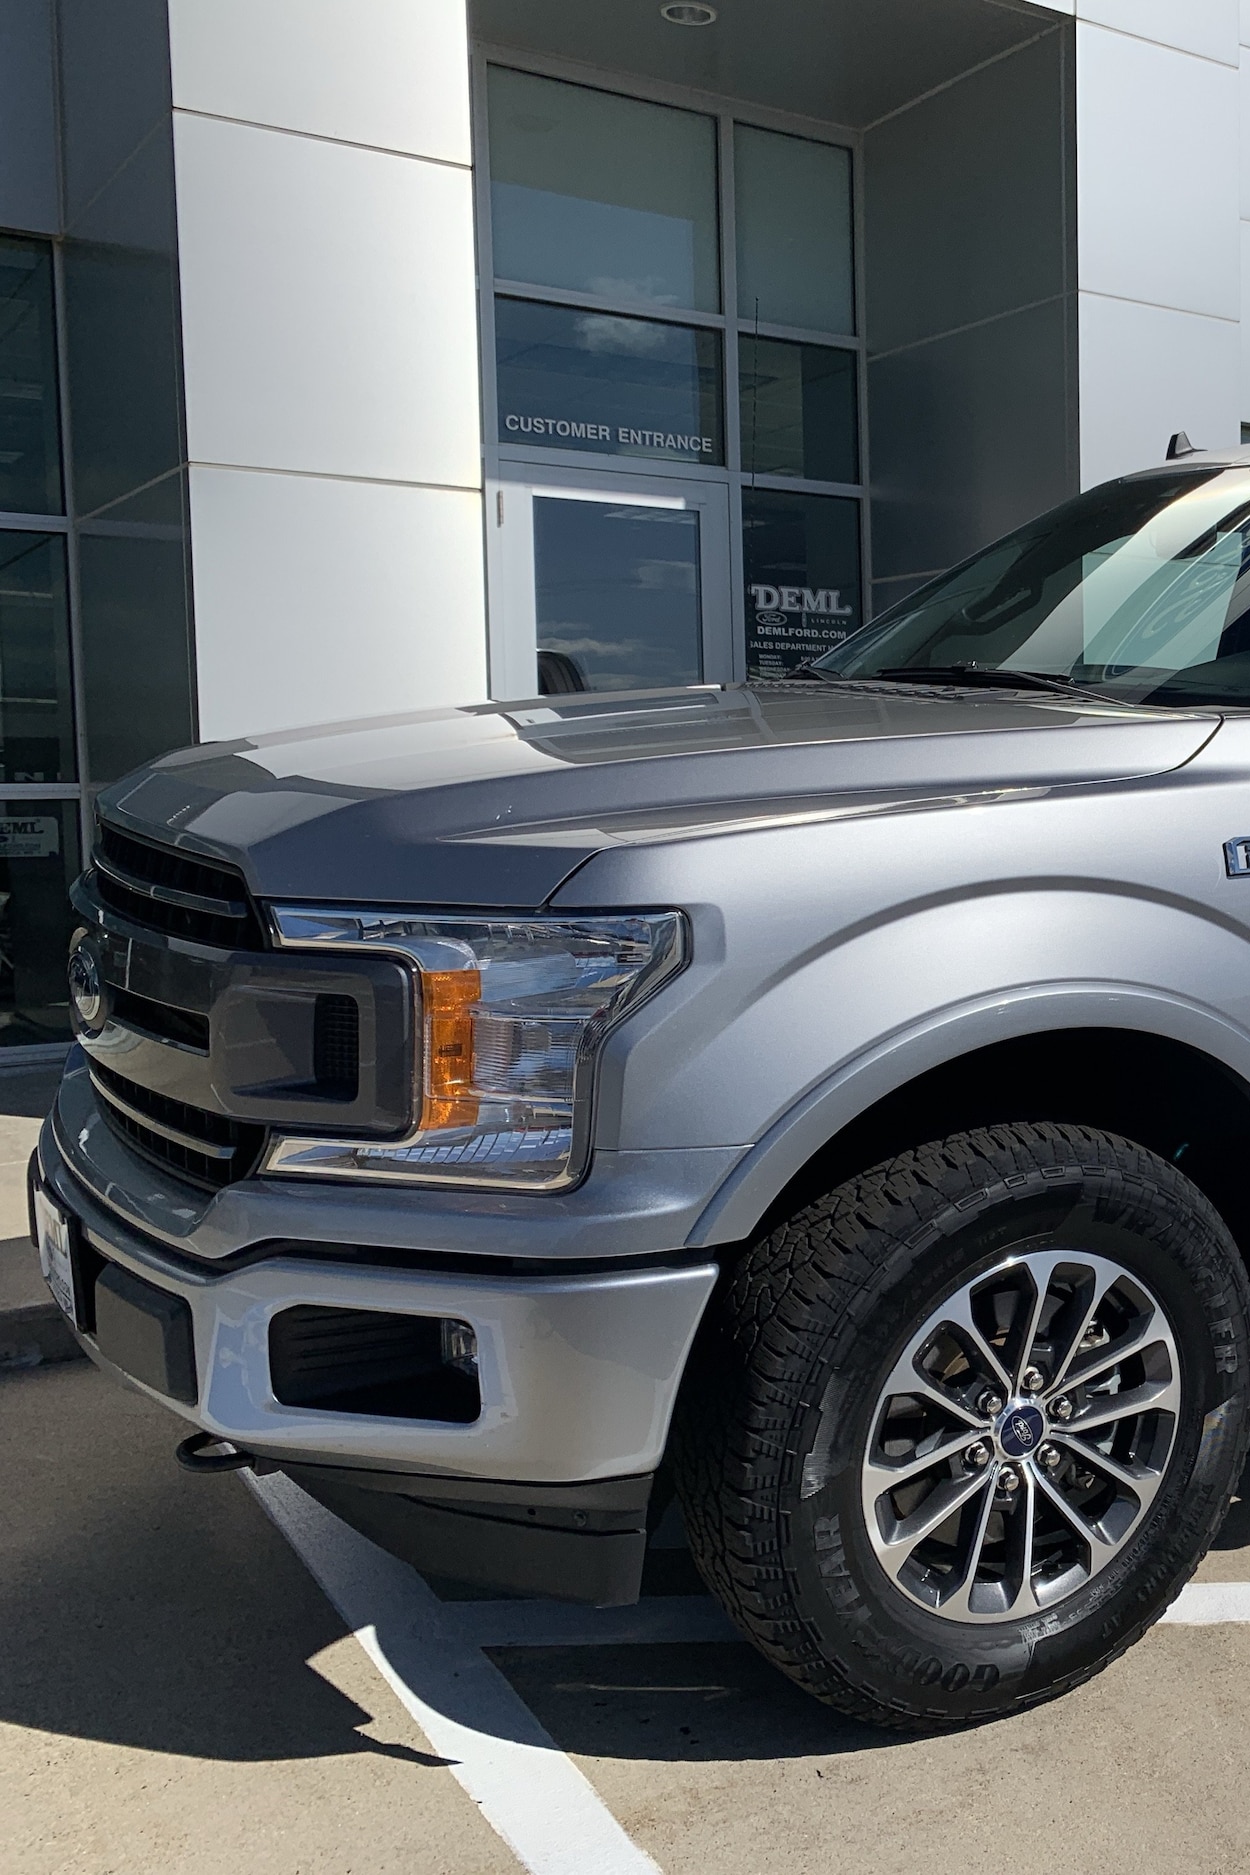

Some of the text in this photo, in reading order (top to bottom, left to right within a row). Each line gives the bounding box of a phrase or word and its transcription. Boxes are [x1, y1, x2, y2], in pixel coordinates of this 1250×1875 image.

[505, 414, 713, 453] CUSTOMER ENTRANCE
[748, 584, 853, 616] DEML
[750, 641, 774, 650] SALES
[775, 642, 826, 653] DEPARTMENT
[757, 626, 847, 640] DEMLFORD.COM
[0, 822, 44, 835] EML
[1091, 1196, 1239, 1374] WRANGLER
[814, 1513, 1001, 1693] GOODYEAR
